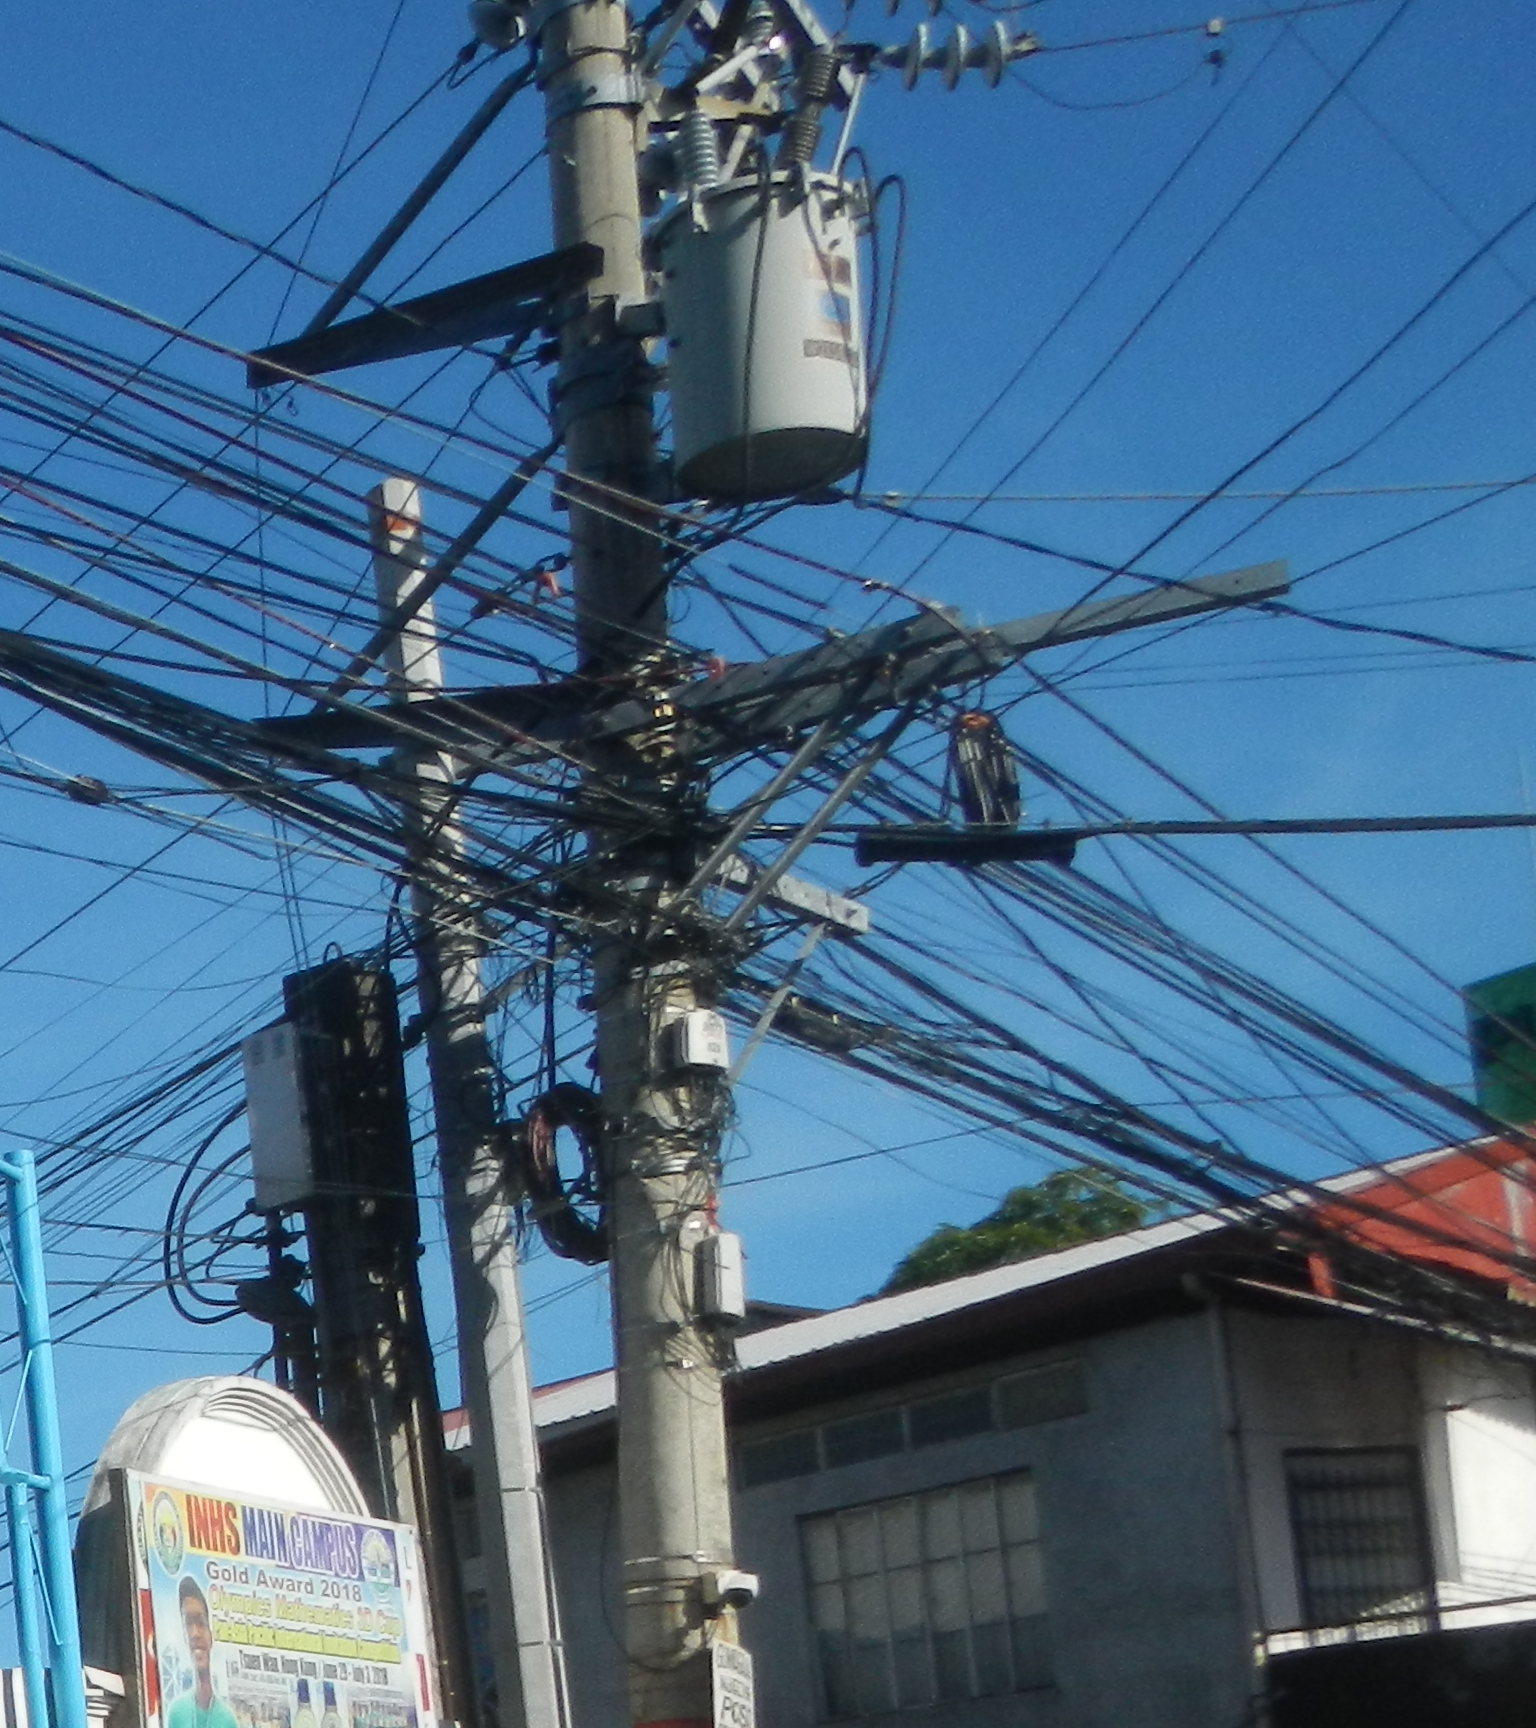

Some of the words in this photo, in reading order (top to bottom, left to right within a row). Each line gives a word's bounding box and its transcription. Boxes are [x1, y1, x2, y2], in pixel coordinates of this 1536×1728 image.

[186, 1494, 241, 1557] INHS
[241, 1506, 289, 1565] MAIN
[289, 1516, 359, 1579] CAMPUS
[206, 1561, 249, 1584] Gold
[257, 1569, 314, 1595] Award
[321, 1580, 362, 1603] 2018
